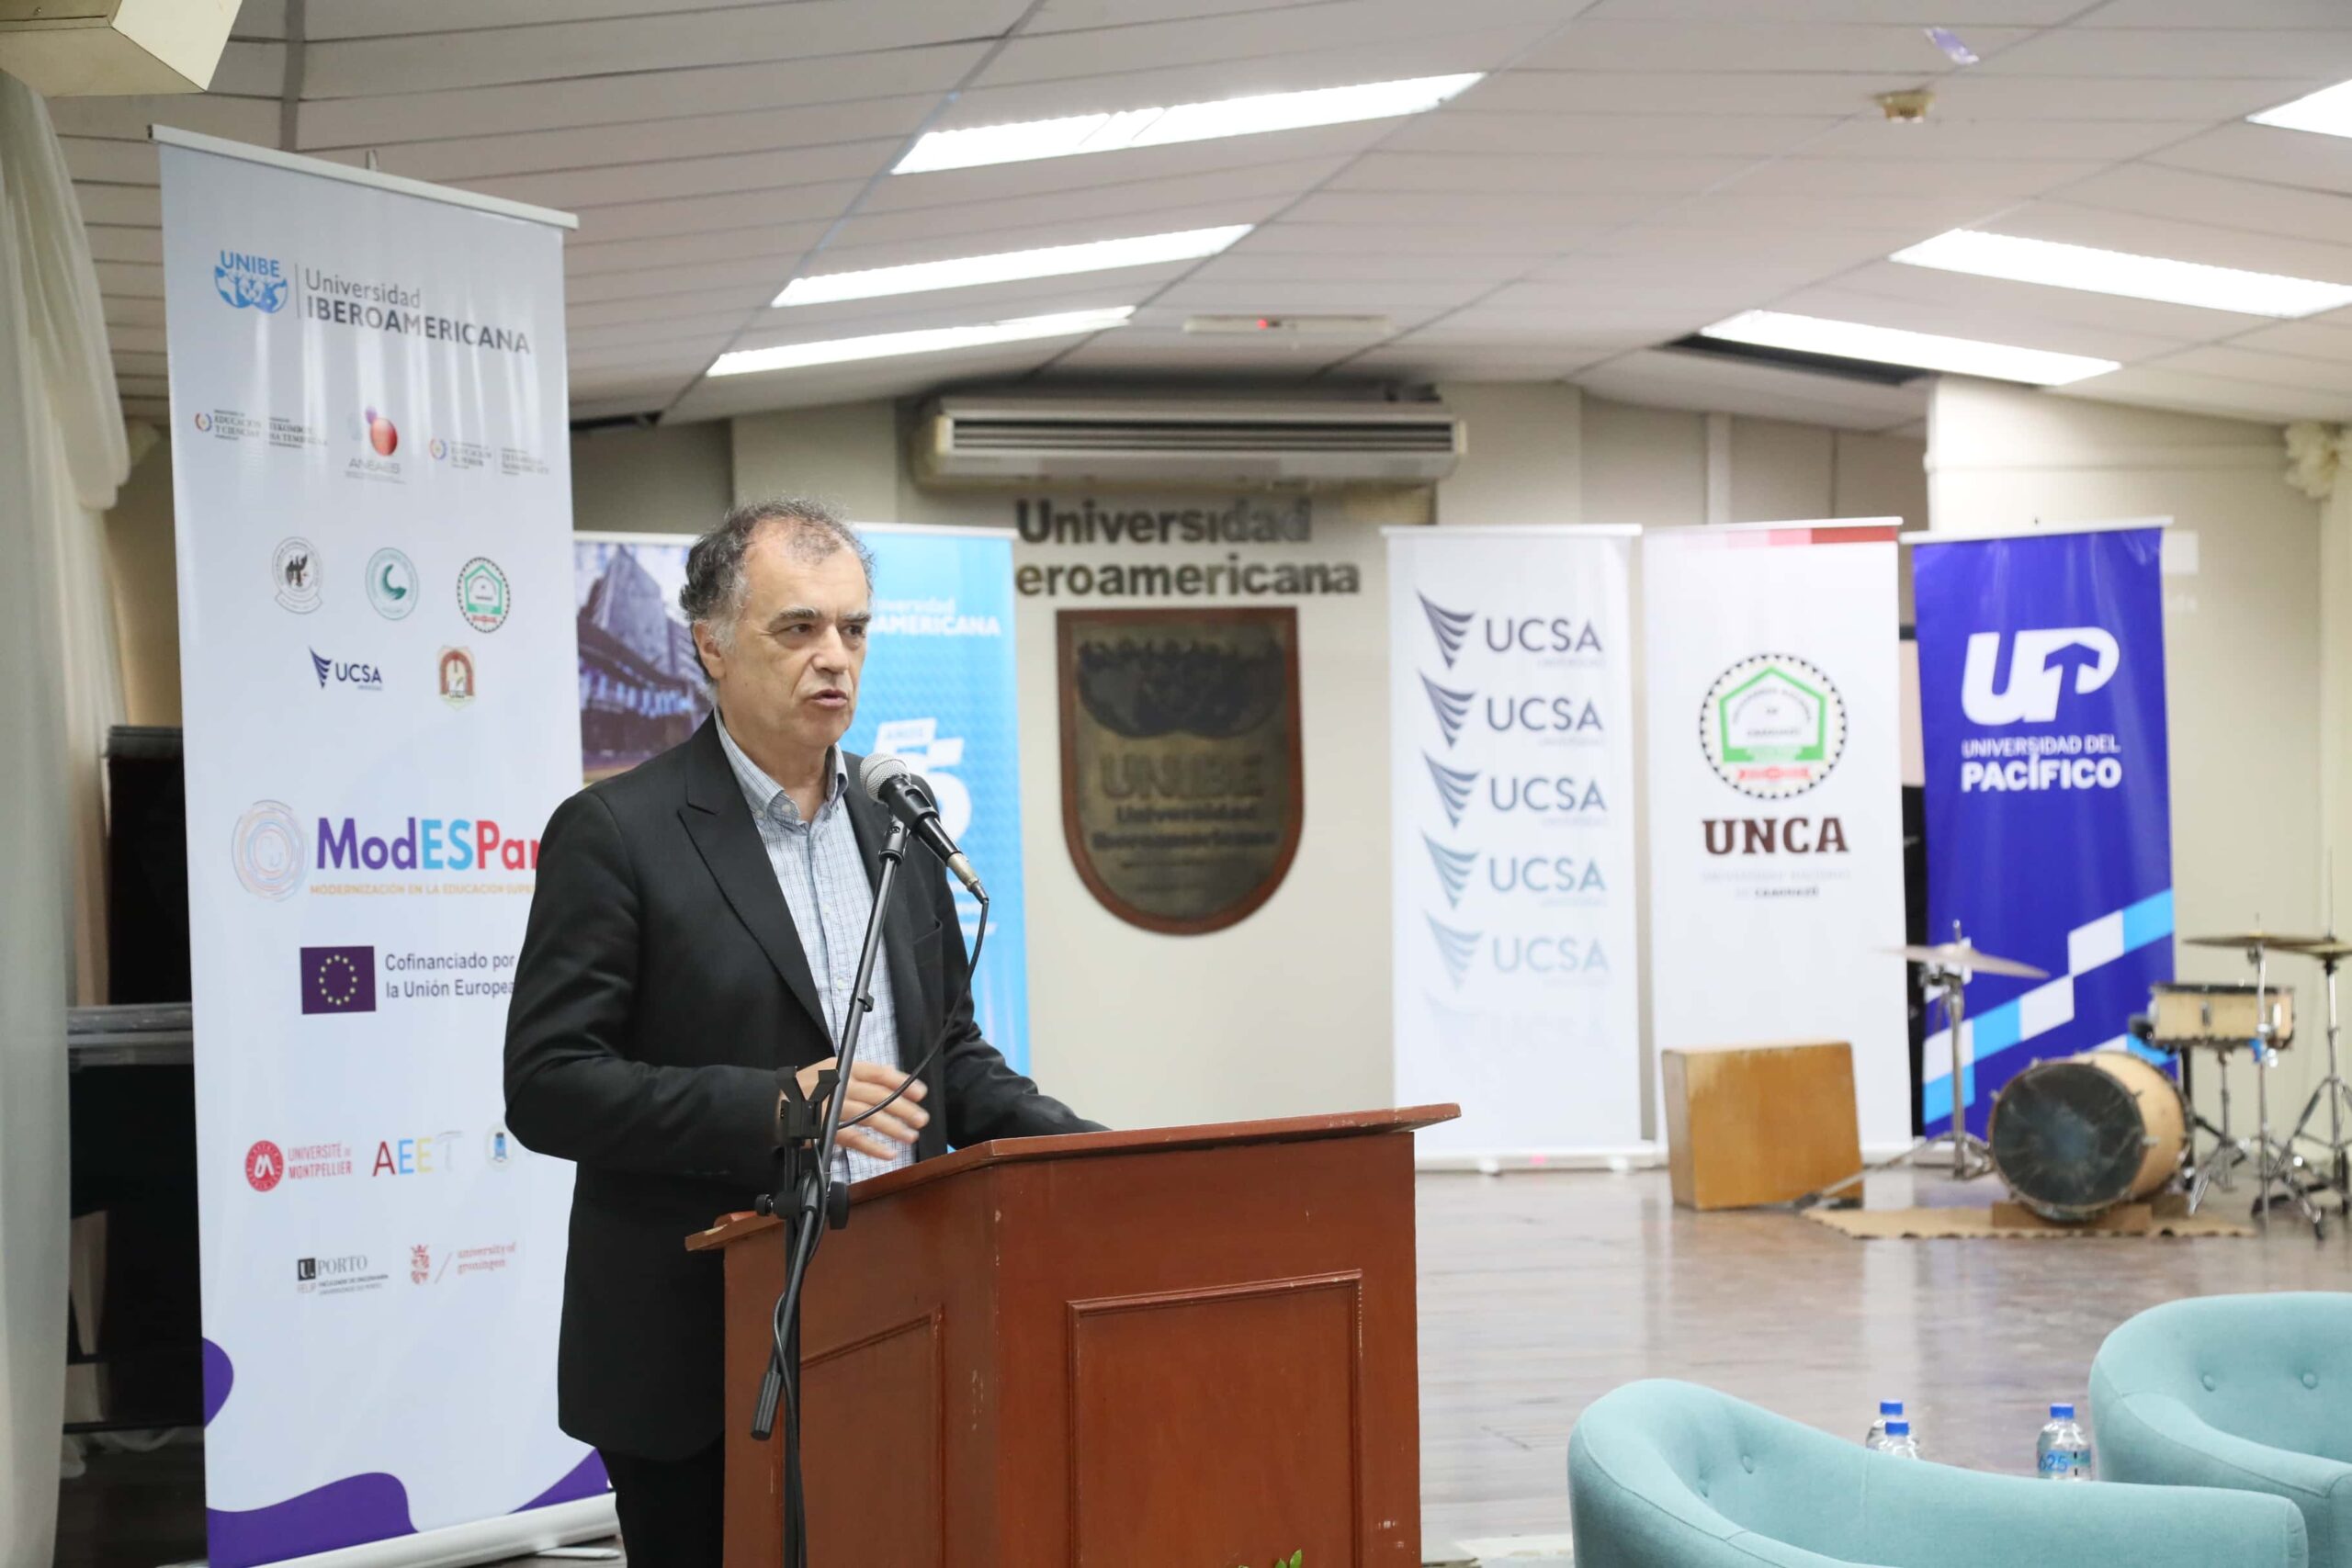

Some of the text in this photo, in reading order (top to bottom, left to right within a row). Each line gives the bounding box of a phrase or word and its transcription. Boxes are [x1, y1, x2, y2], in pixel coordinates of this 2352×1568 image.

[220, 250, 280, 277] UNIBE
[305, 268, 422, 310] Universidad
[306, 294, 532, 356] IBEROAMERICANA
[1017, 500, 1312, 544] Universidad
[1015, 553, 1361, 597] eroamericana
[868, 615, 1001, 636] AMERICANA
[1485, 618, 1602, 653] UCSA
[335, 662, 383, 685] UCSA
[1487, 697, 1604, 732] UCSA
[1962, 734, 2120, 758] UNIVERSIDAD DEL
[1961, 753, 2122, 793] PACÍFICO
[1489, 777, 1608, 813] UCSA
[1702, 817, 1850, 856] UNCA
[310, 882, 404, 896] MODERNIZACIÓN
[408, 883, 423, 895] EN
[425, 883, 440, 895] LA
[1488, 857, 1608, 893] UCSA
[385, 953, 514, 972] Cofinanciado por
[1492, 937, 1611, 974] UCSA
[386, 982, 399, 998] la
[404, 978, 449, 998] Unión
[288, 1142, 342, 1161] UNIVERSITÉ
[288, 1160, 352, 1179] MONTPELLIER
[317, 1255, 368, 1277] PORTO
